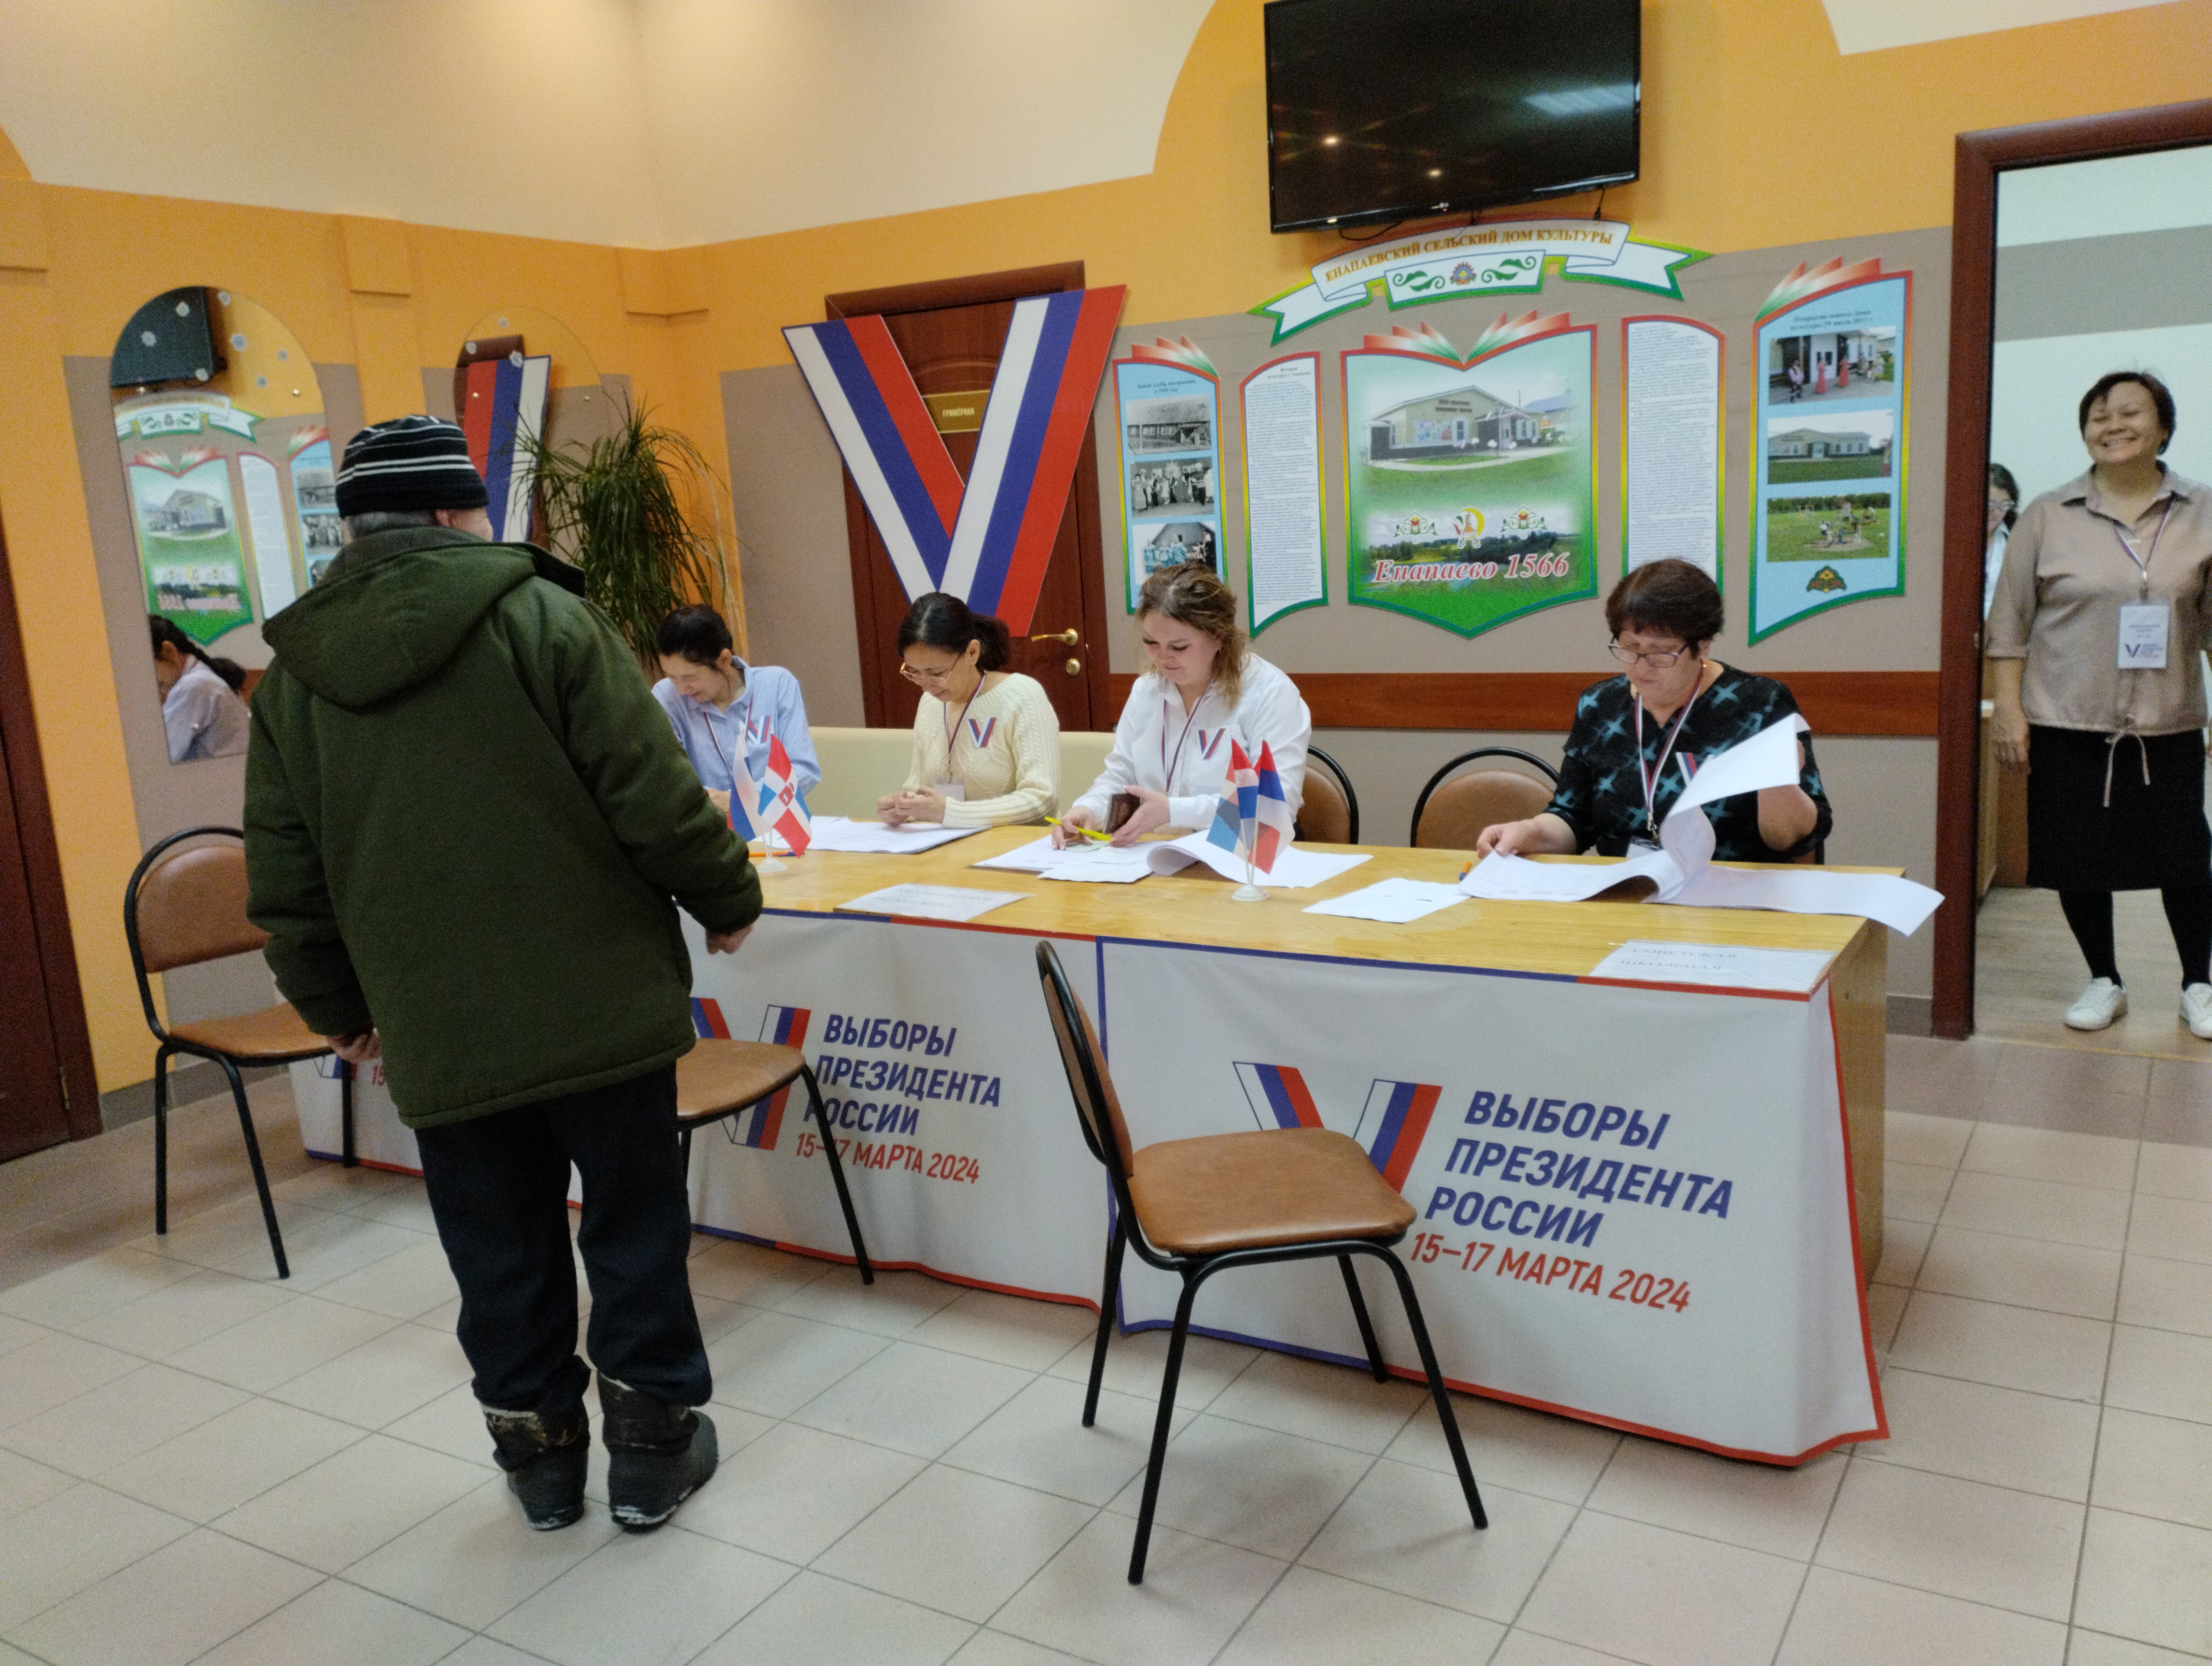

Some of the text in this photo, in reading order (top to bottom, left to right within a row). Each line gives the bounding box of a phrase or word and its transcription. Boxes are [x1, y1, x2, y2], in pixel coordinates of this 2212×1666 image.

[1325, 228, 1613, 282] ЕНАПАЕВСКИЙ СЕЛЬСКИЙ ДОМ КУЛЬТУРЫ
[1372, 552, 1570, 584] Енапаево 1566
[824, 1014, 957, 1057] ВЫБОРЫ
[815, 1055, 1001, 1107] ПРЕЗИДЕНТА
[1464, 1090, 1671, 1150] ВЫБОРЫ
[852, 1142, 923, 1174] МАРТА
[927, 1153, 979, 1184] 2024
[1444, 1138, 1734, 1219] ПРЕЗИДЕНТА
[1424, 1186, 1604, 1248] РОССИИ
[1496, 1247, 1604, 1296] МАРТА
[1608, 1269, 1691, 1313] 2024
